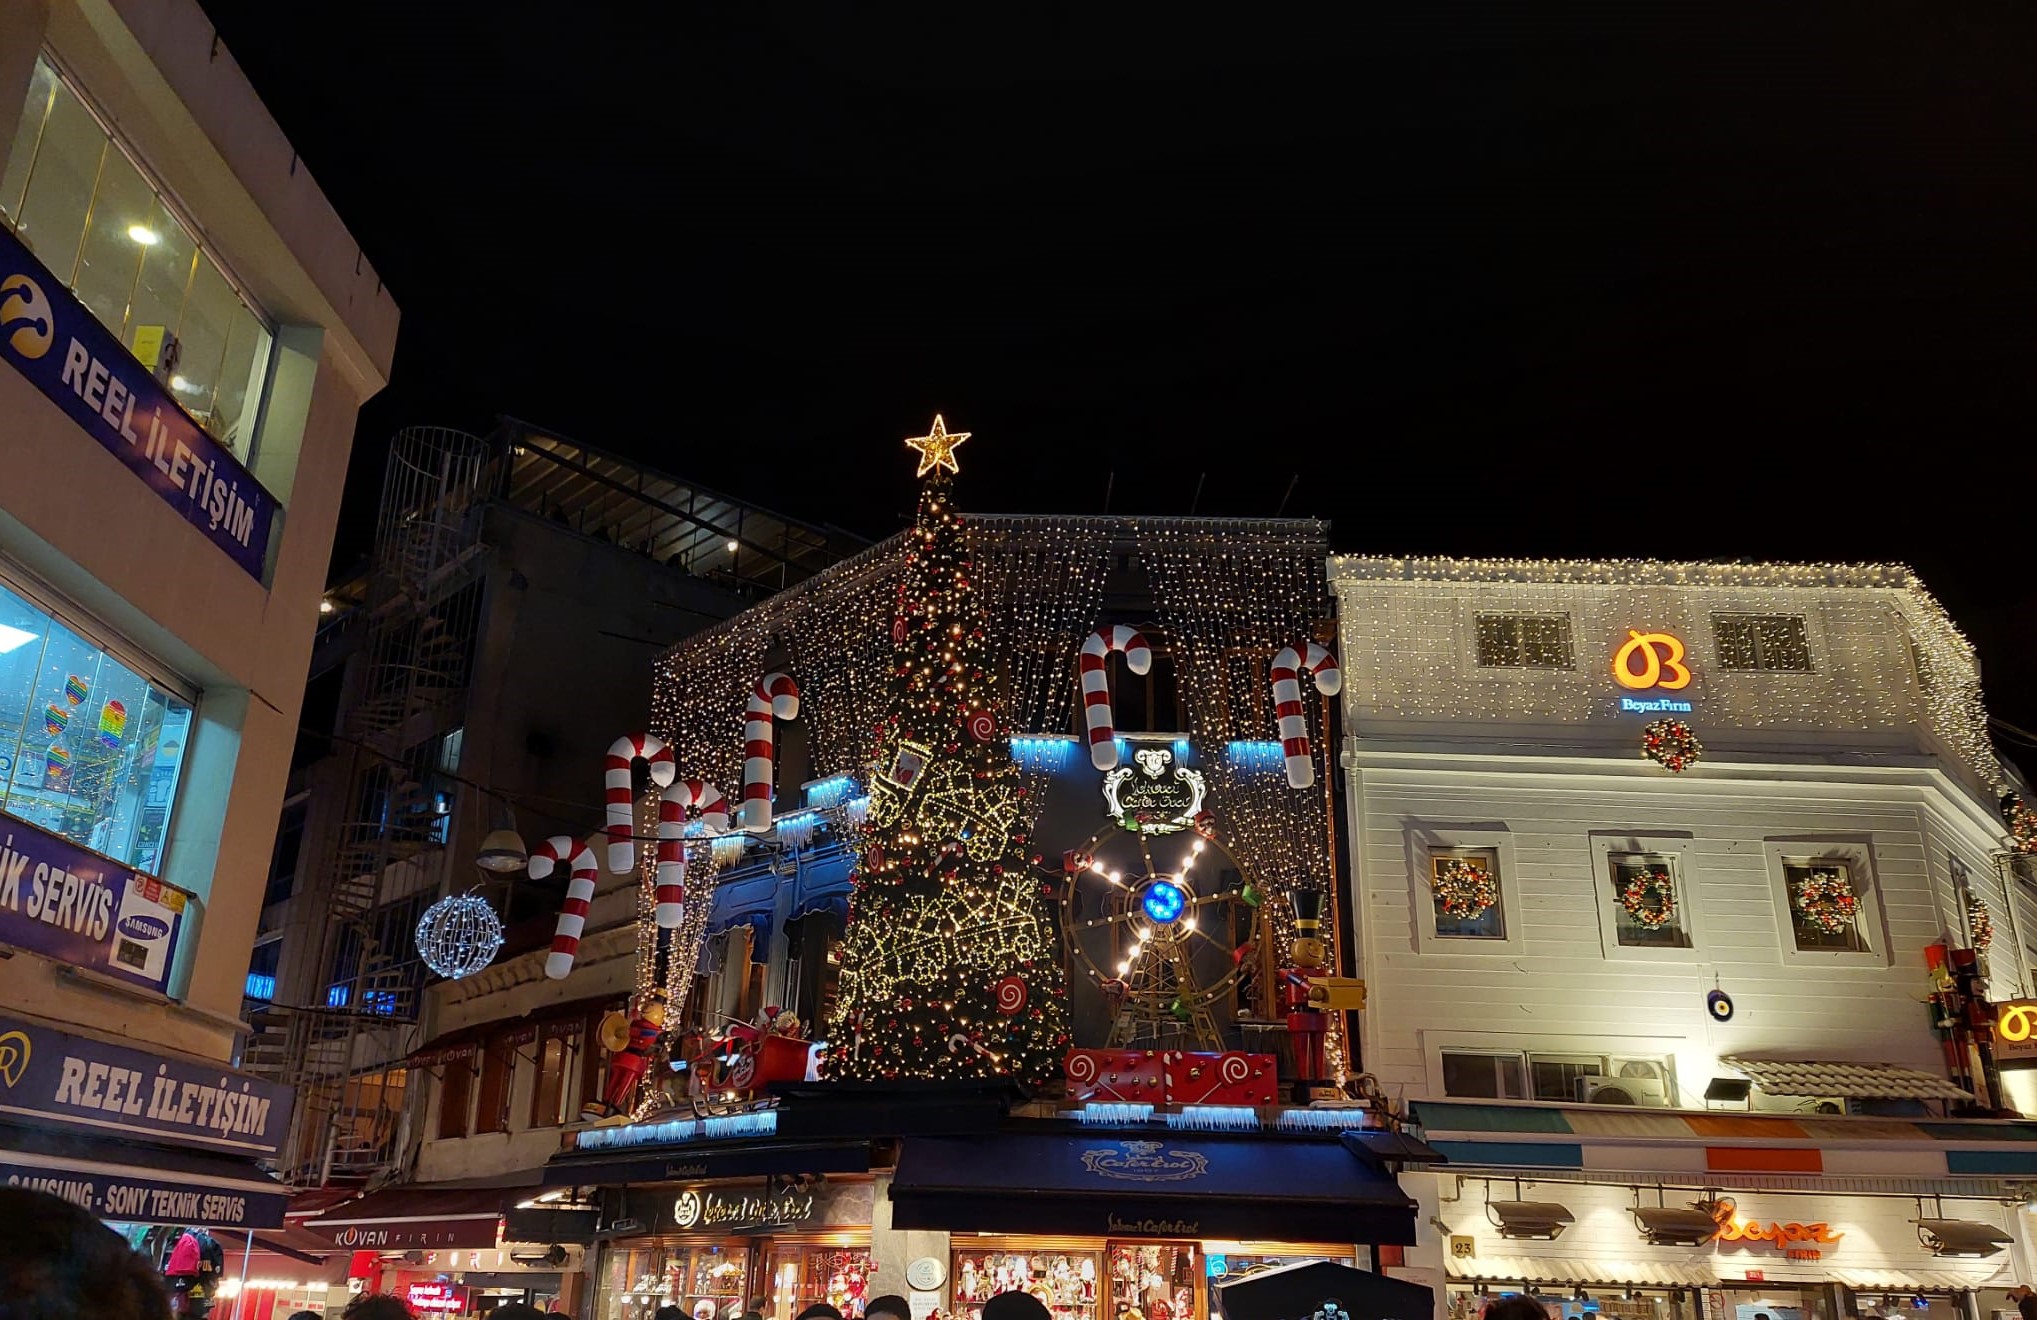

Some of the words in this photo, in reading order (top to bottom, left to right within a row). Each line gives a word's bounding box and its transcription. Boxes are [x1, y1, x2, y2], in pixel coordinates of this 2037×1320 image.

[62, 337, 137, 446] REEL
[144, 407, 255, 547] İLETİŞİM
[1621, 699, 1660, 713] Beyaz
[1661, 700, 1692, 712] Fırın
[27, 862, 113, 941] SERVİS
[125, 916, 164, 938] SAMSUNG
[55, 1056, 143, 1115] REEL
[147, 1063, 270, 1138] İLETİŞİM
[105, 1184, 149, 1214] SONY
[335, 1226, 388, 1246] KOVAN
[395, 1232, 454, 1245] FIRIN
[1455, 1243, 1471, 1254] 23
